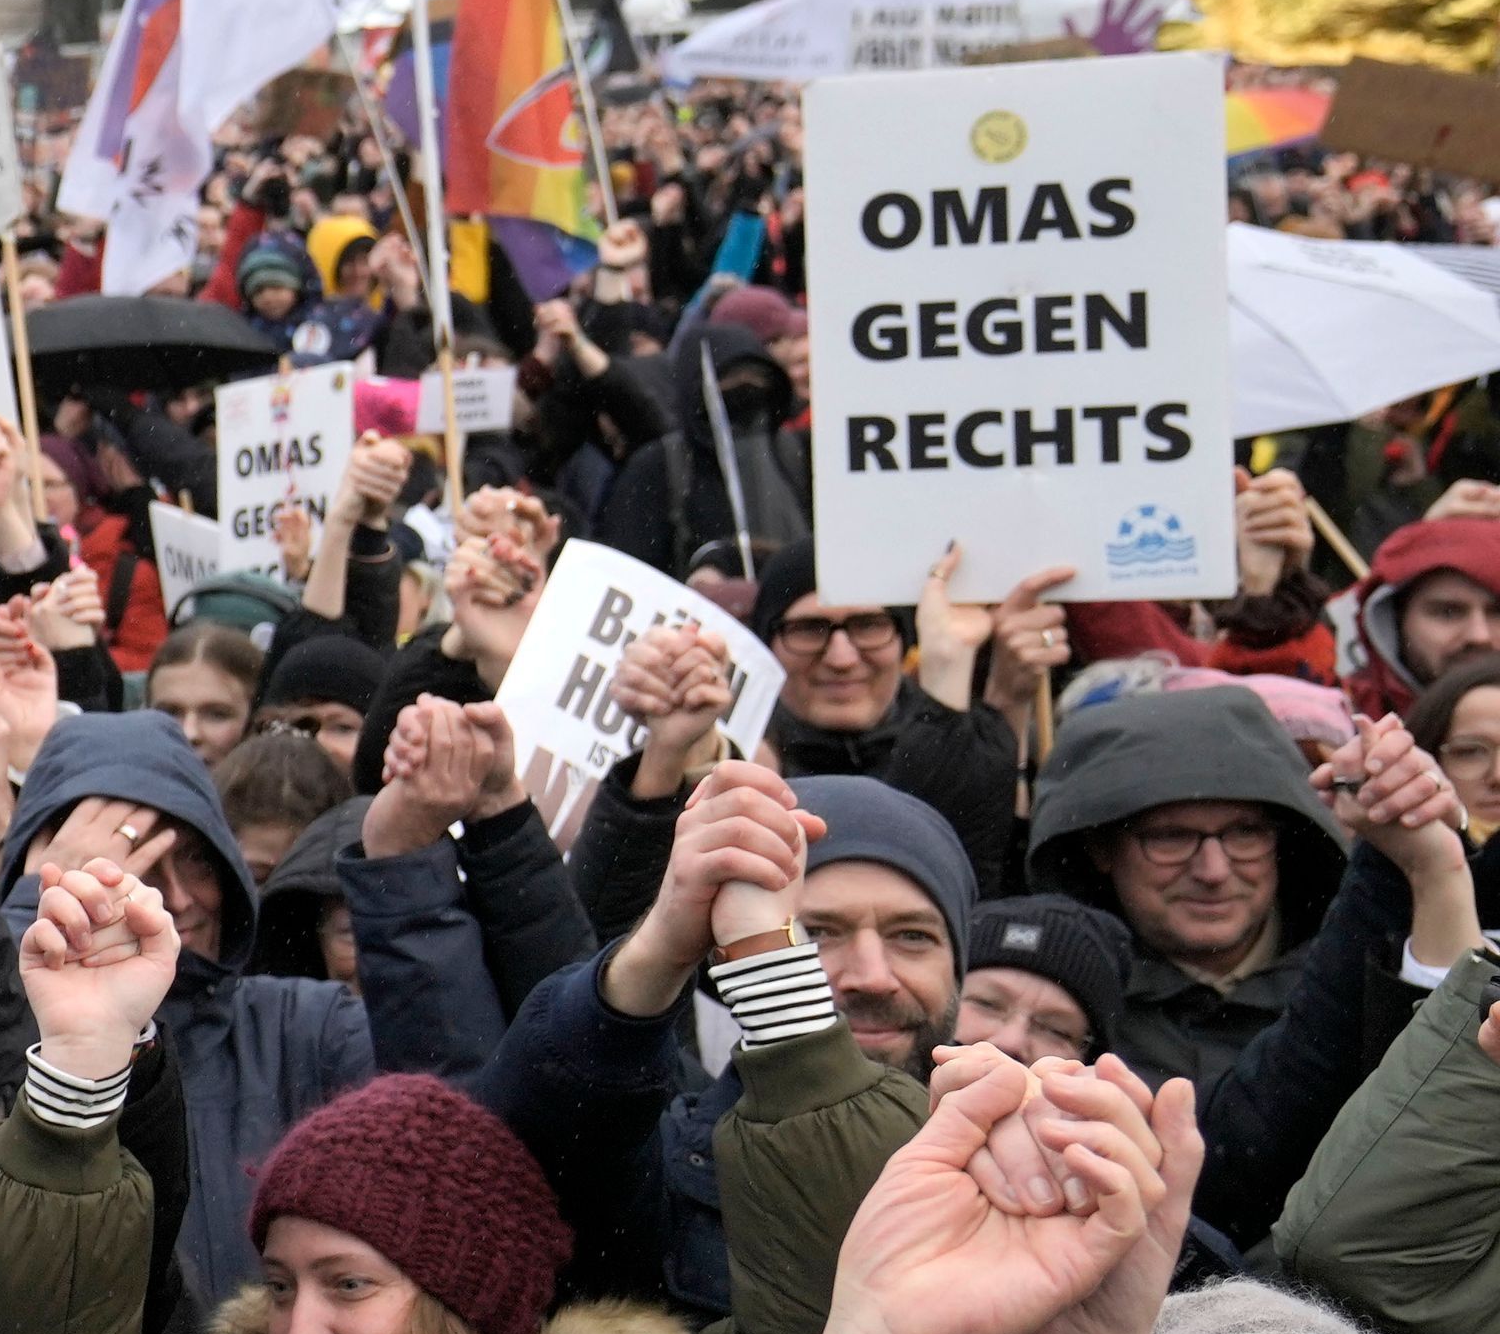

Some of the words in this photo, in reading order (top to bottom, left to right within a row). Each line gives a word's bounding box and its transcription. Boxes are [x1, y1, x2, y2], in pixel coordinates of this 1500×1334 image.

[859, 177, 1137, 251] OMAS
[850, 290, 1150, 363] GEGEN
[235, 433, 323, 479] OMAS
[846, 402, 1194, 473] RECHTS
[232, 495, 327, 539] GEN
